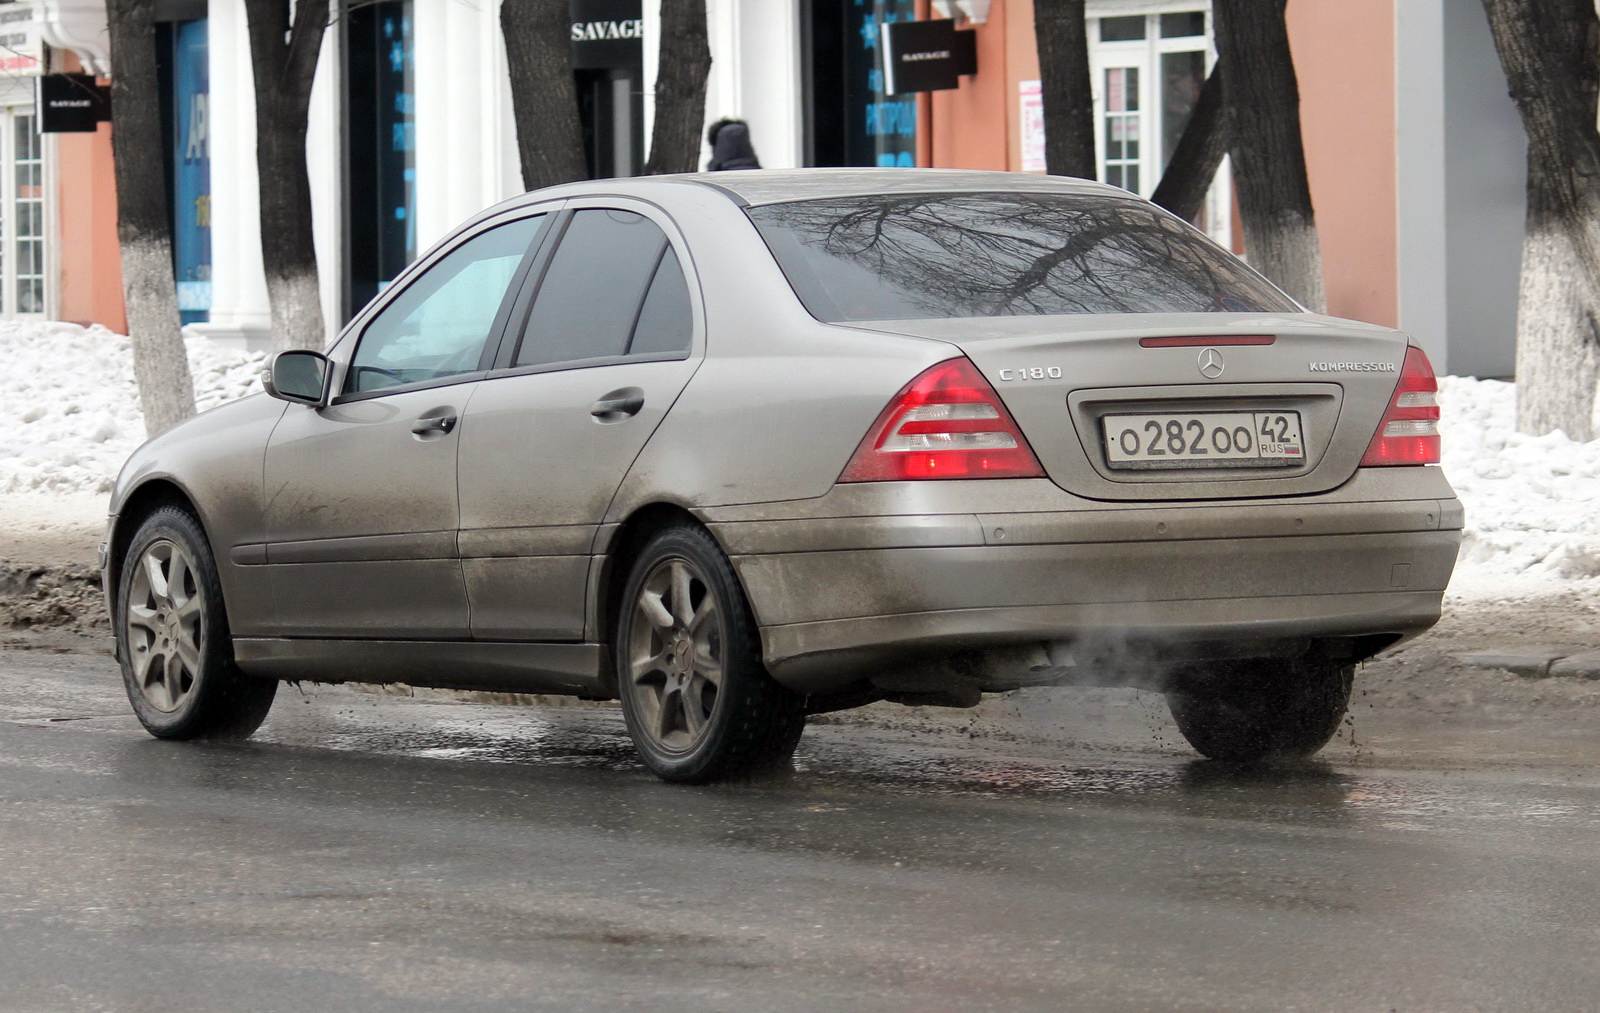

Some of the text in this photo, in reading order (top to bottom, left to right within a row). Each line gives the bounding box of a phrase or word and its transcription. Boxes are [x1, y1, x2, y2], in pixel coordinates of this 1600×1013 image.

[1308, 362, 1395, 372] KOMPRESSOR
[999, 366, 1062, 381] C 180
[1260, 415, 1291, 443] 42
[1261, 444, 1284, 453] RUS
